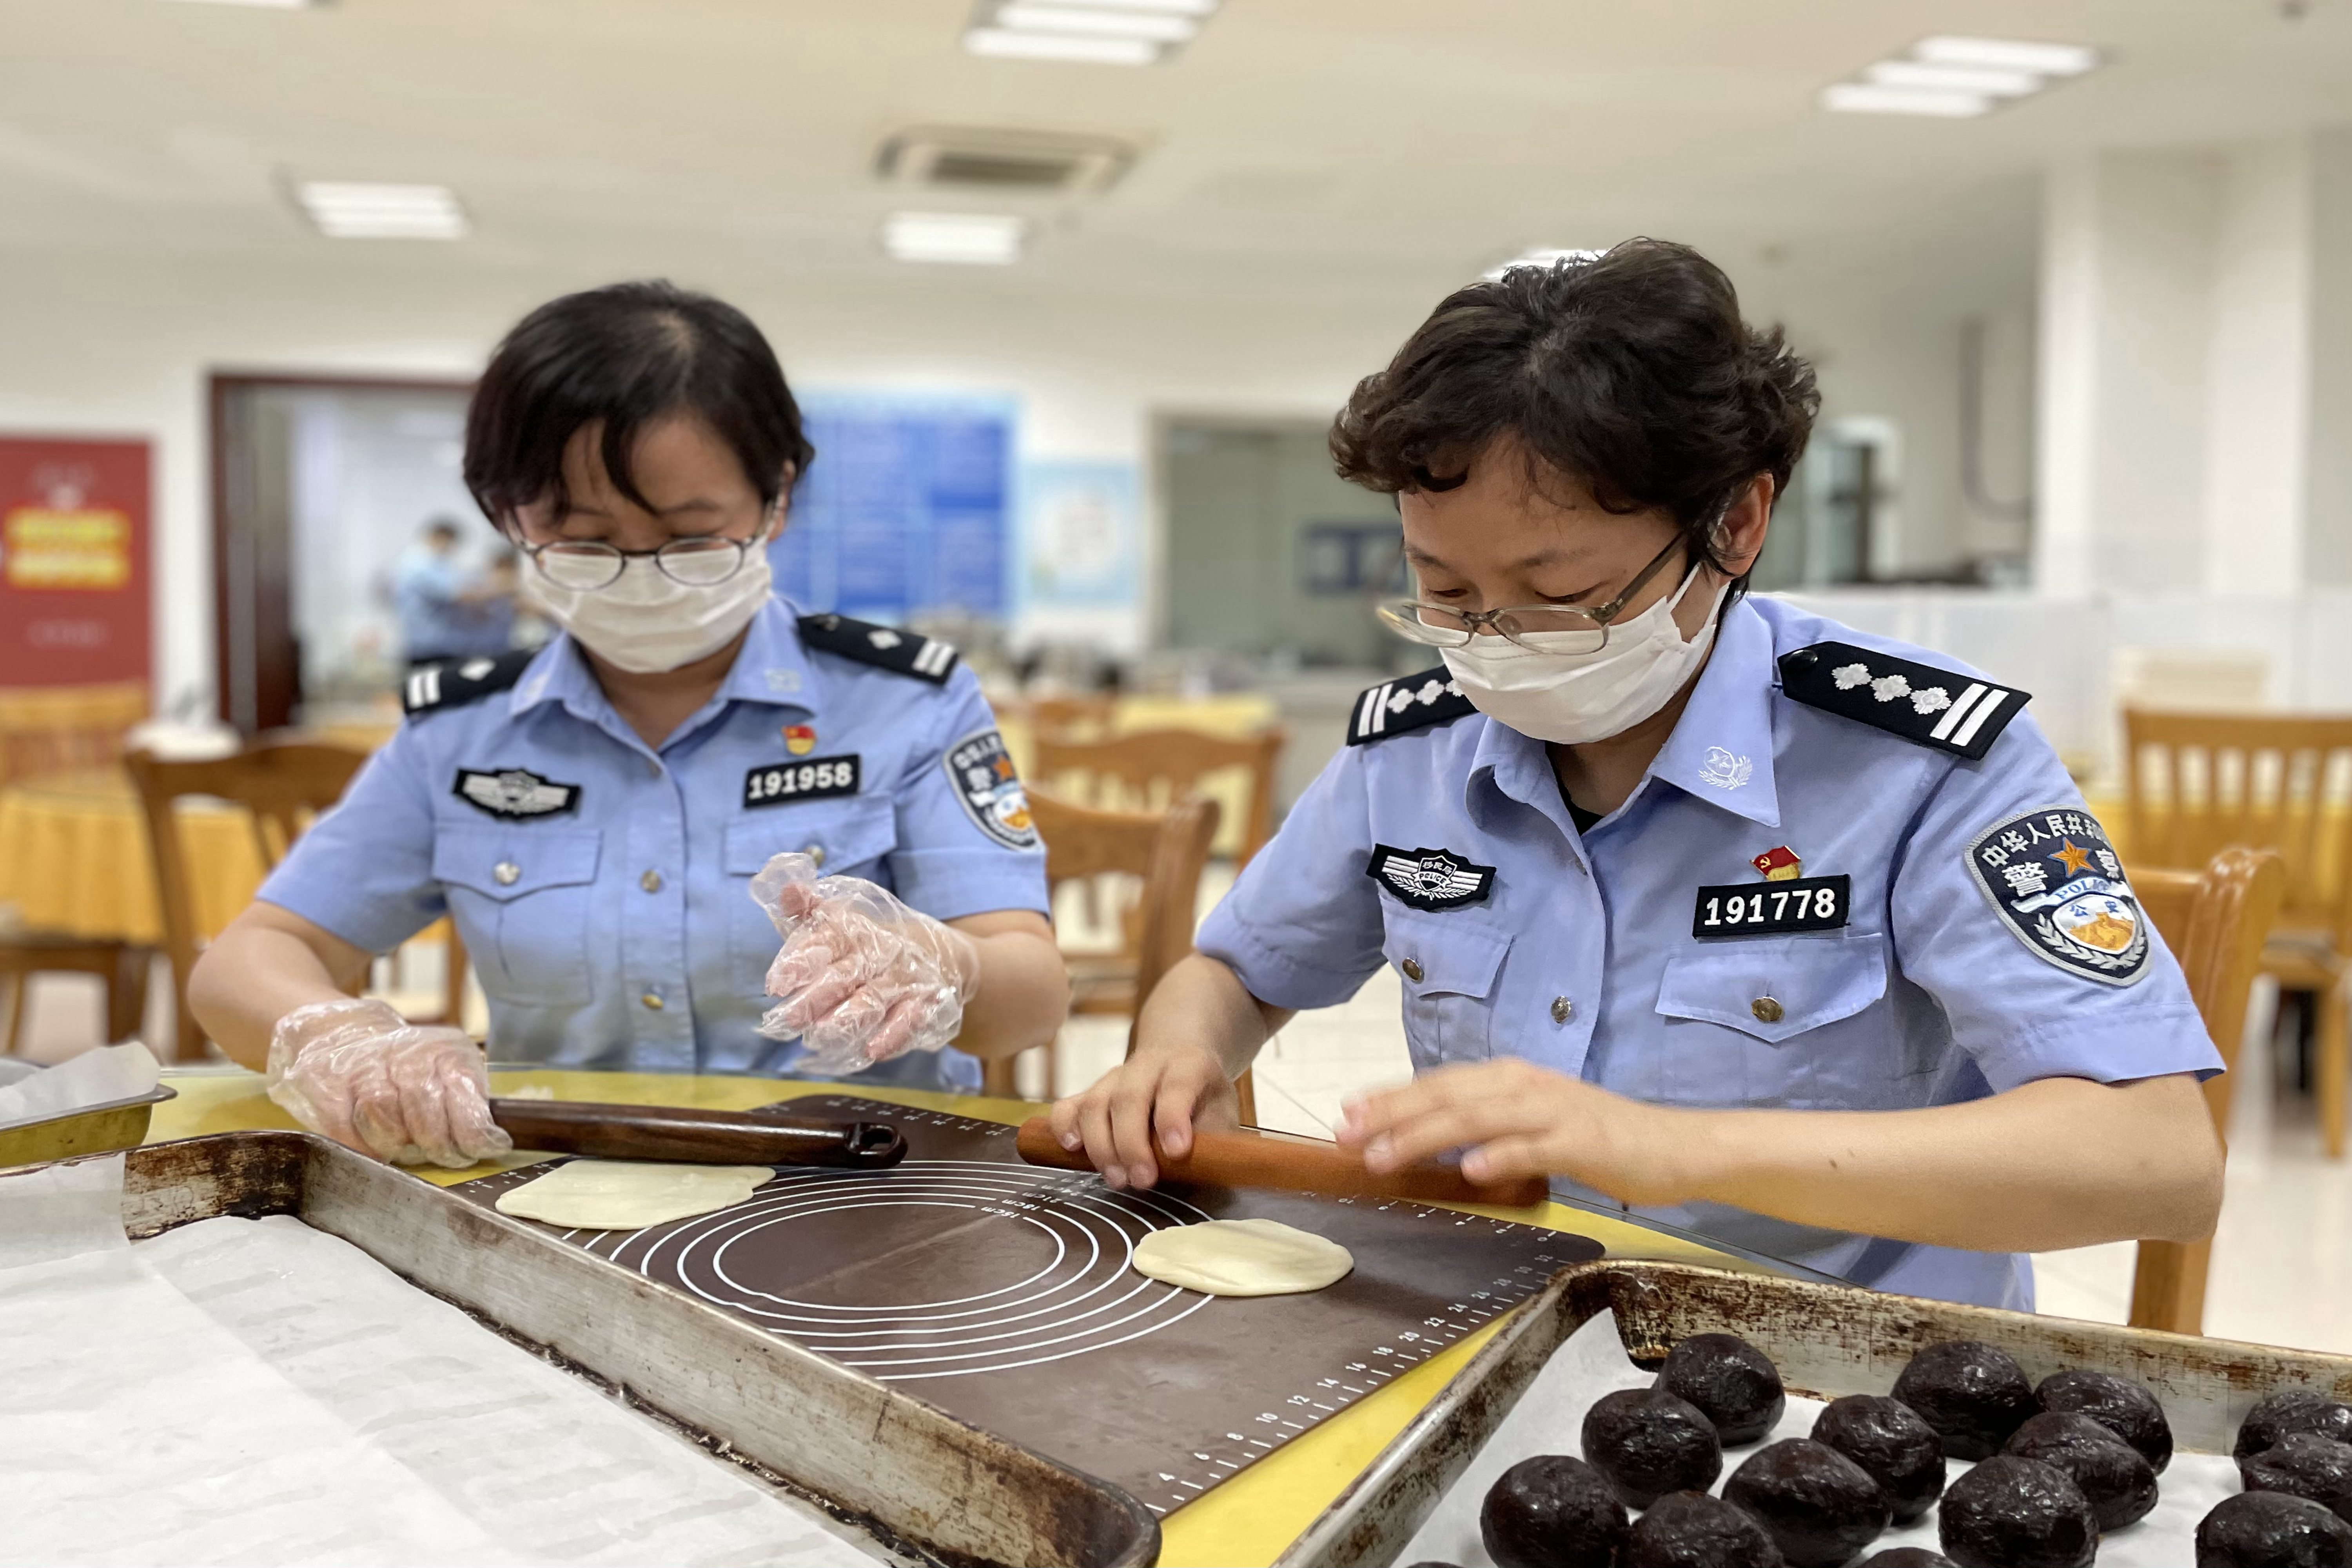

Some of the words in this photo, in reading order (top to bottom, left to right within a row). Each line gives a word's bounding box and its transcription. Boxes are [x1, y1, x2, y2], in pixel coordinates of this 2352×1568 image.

[748, 762, 853, 800] 191958
[1982, 813, 2114, 868] 中华人民共和
[2002, 862, 2049, 897] 警
[1704, 888, 1835, 926] 191778
[1001, 1199, 1041, 1211] 18cm
[1022, 1192, 1063, 1203] 21cm
[1041, 1185, 1082, 1196] 24cm
[980, 1206, 1020, 1218] 15cm
[1159, 1472, 1175, 1482] 4
[1227, 1432, 1244, 1441] 8
[1256, 1412, 1278, 1423] 10
[1287, 1395, 1310, 1405] 12
[1316, 1378, 1339, 1388] 14
[1345, 1362, 1367, 1372] 16
[1372, 1346, 1394, 1356] 18
[1398, 1331, 1420, 1342] 20
[1424, 1317, 1446, 1327] 22
[1448, 1303, 1469, 1313] 24
[1471, 1290, 1490, 1299] 26
[1493, 1278, 1512, 1287] 28
